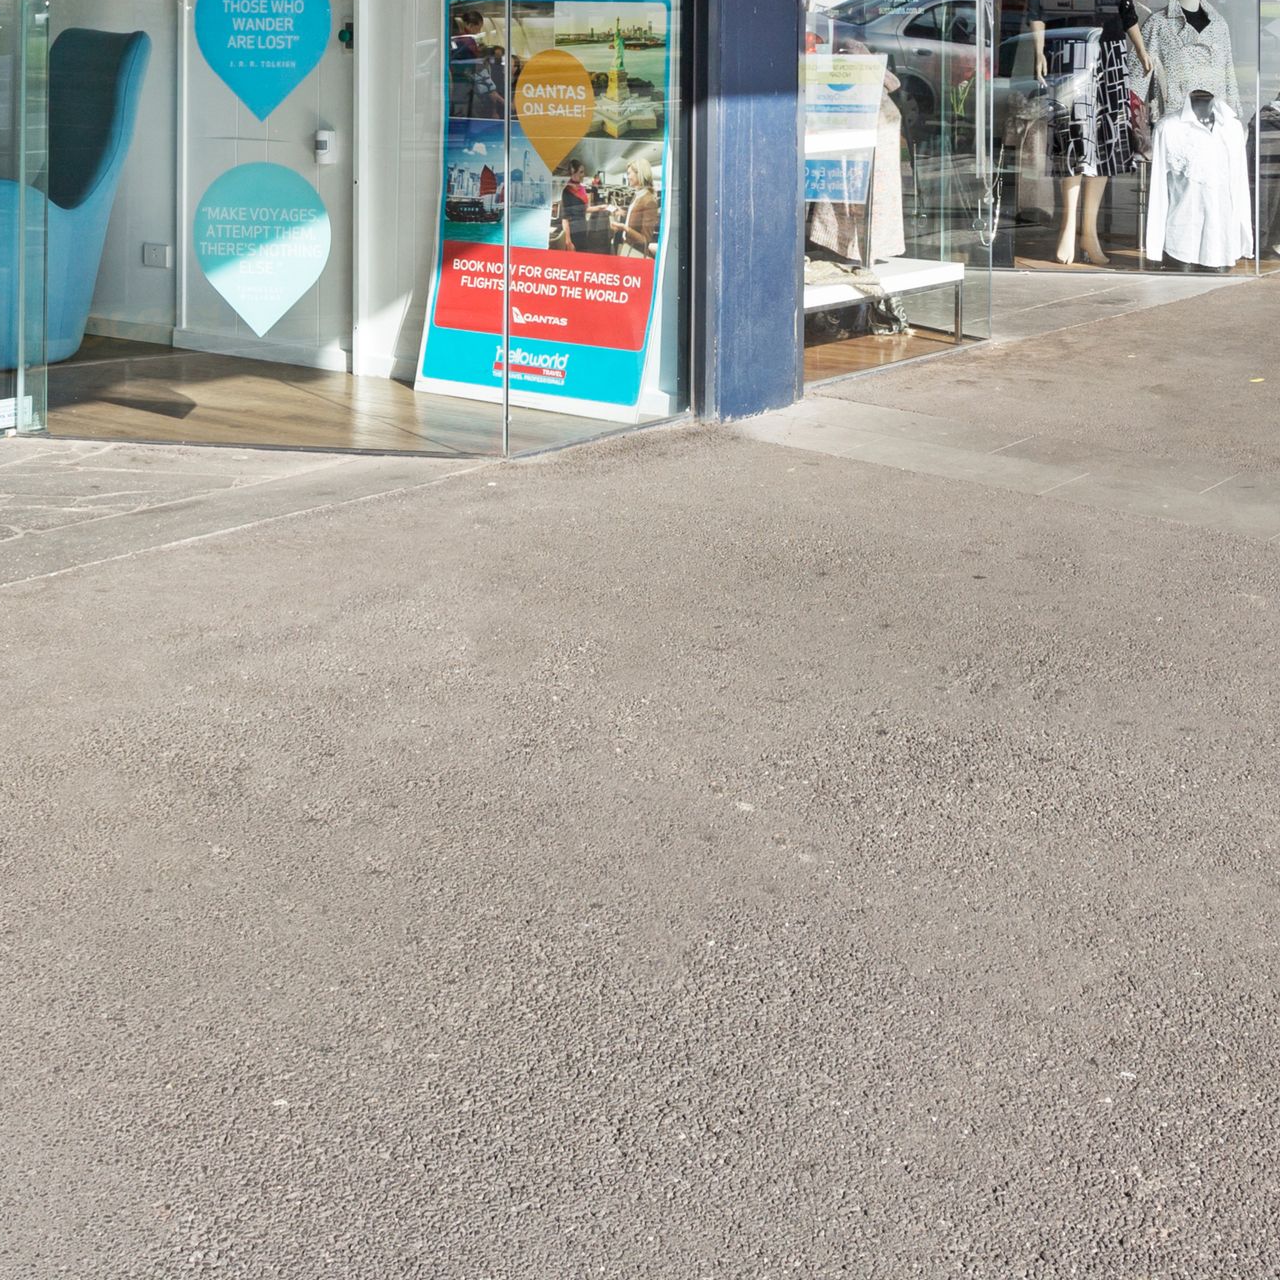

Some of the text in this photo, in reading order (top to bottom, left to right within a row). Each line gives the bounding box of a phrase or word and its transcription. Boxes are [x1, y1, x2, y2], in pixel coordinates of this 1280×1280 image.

[222, 0, 304, 13] THOSE WHO
[232, 17, 294, 31] WANDER
[227, 35, 255, 49] ARE
[522, 82, 587, 101] QANTAS
[522, 102, 587, 118] ON SALE!
[206, 224, 271, 239] ATTEMPT
[200, 241, 322, 258] THERE'S NOTHING
[453, 258, 485, 271] BOOK
[518, 265, 543, 279] FOR
[544, 268, 582, 282] GREAT
[583, 272, 620, 286] FARES
[622, 275, 641, 289] ON
[460, 275, 629, 304] FLIGHTS AROUND THE WORLD
[525, 312, 569, 326] QANTAS
[542, 369, 563, 378] TRAVEL
